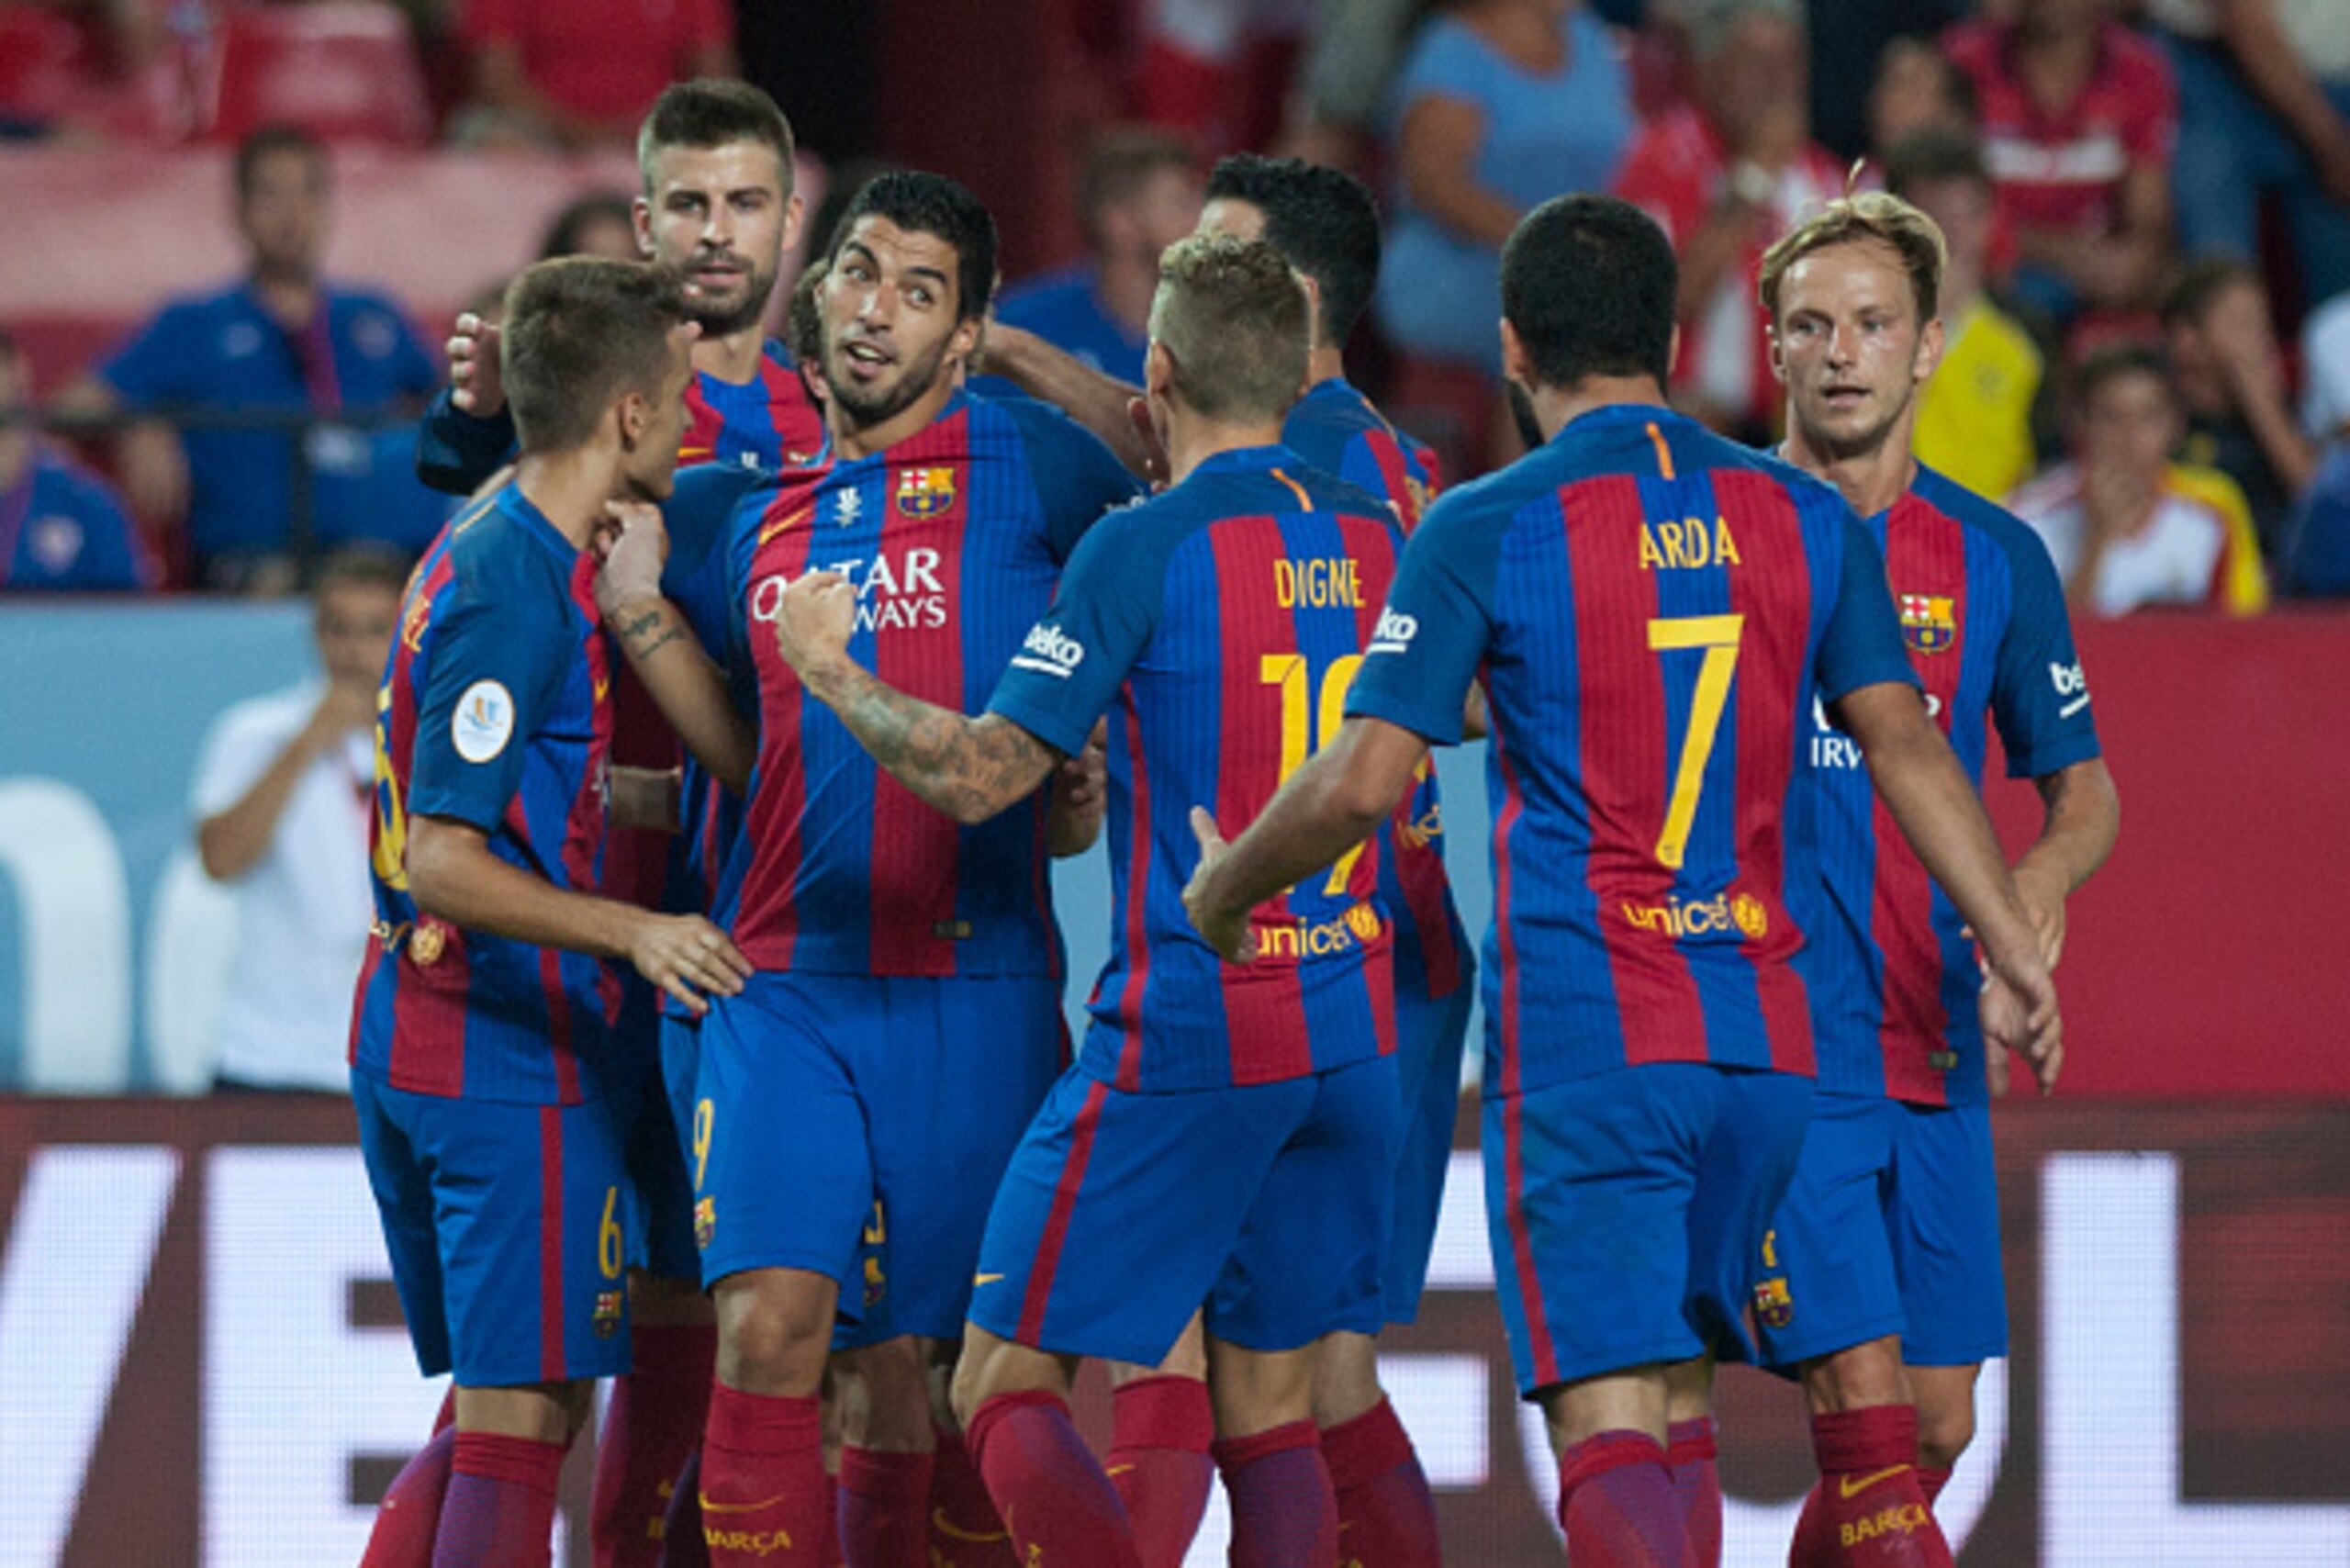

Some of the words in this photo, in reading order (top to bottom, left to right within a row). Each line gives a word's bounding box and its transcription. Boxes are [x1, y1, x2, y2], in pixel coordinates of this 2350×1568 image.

[1639, 516, 1741, 570] ARDA
[753, 548, 946, 622] QTAR
[1273, 557, 1366, 608] DIGNE
[853, 595, 947, 633] WAYS
[1374, 605, 1417, 641] ko
[1647, 613, 1745, 869] 7
[693, 1098, 714, 1192] 9
[599, 1185, 623, 1280] 6
[704, 1527, 792, 1557] ARÇA
[1841, 1504, 1929, 1546] BARÇA
